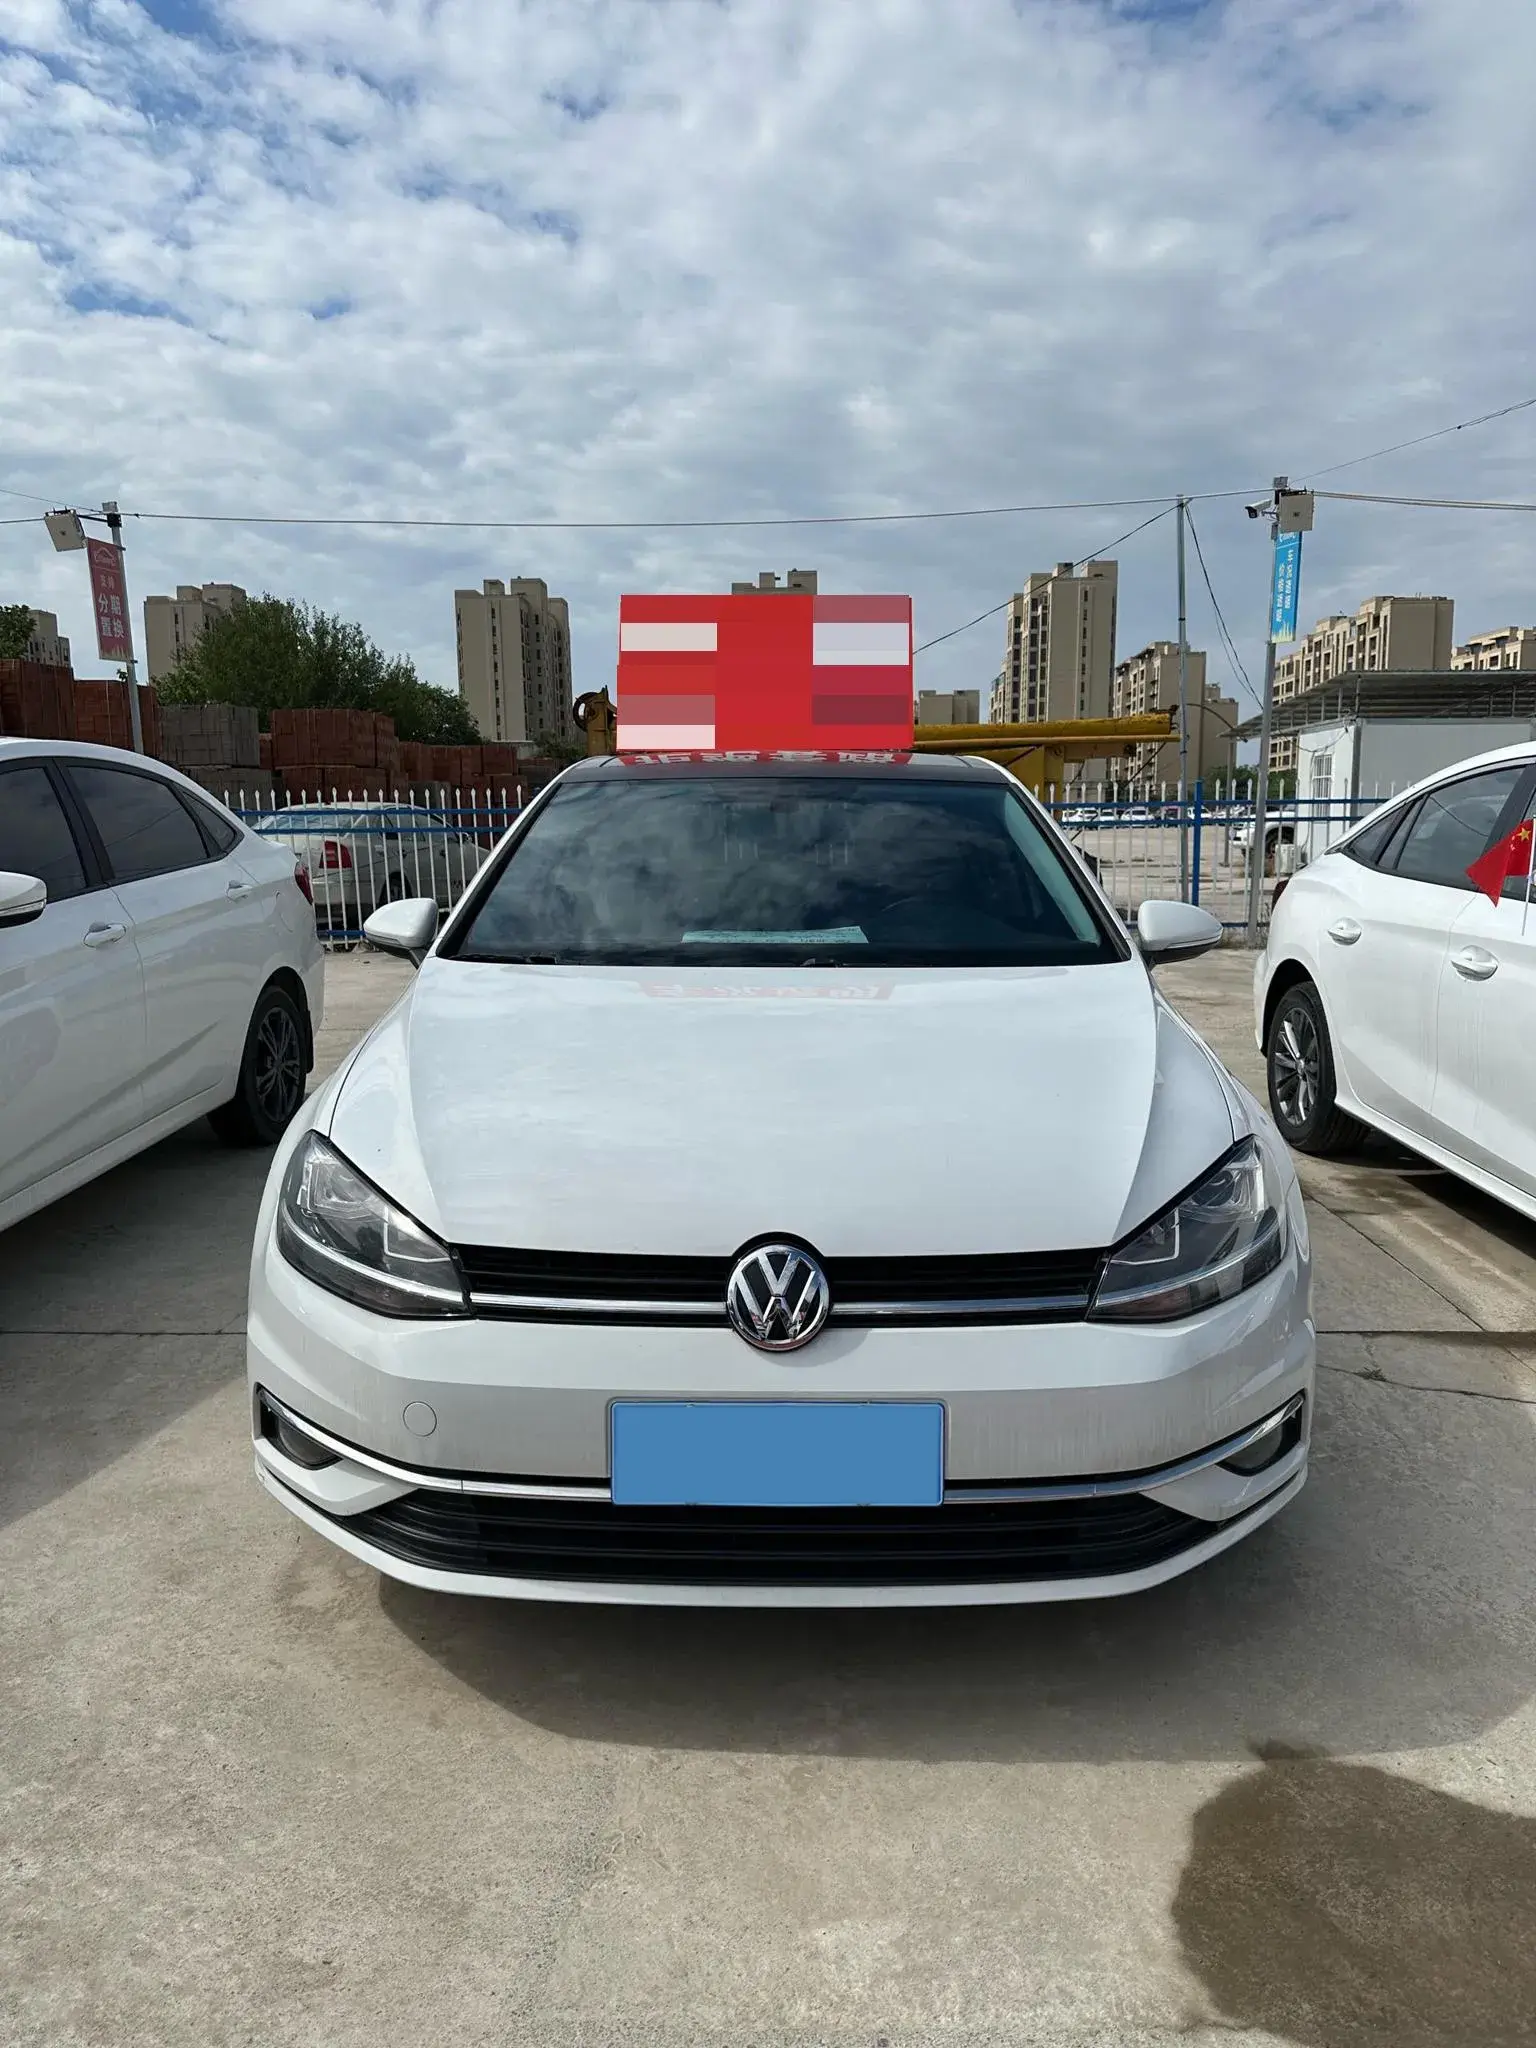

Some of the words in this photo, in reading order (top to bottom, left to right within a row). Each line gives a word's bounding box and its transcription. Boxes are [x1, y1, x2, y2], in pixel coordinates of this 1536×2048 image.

[98, 593, 122, 616] 分期
[101, 616, 125, 639] 置换
[731, 1247, 826, 1347] VW
